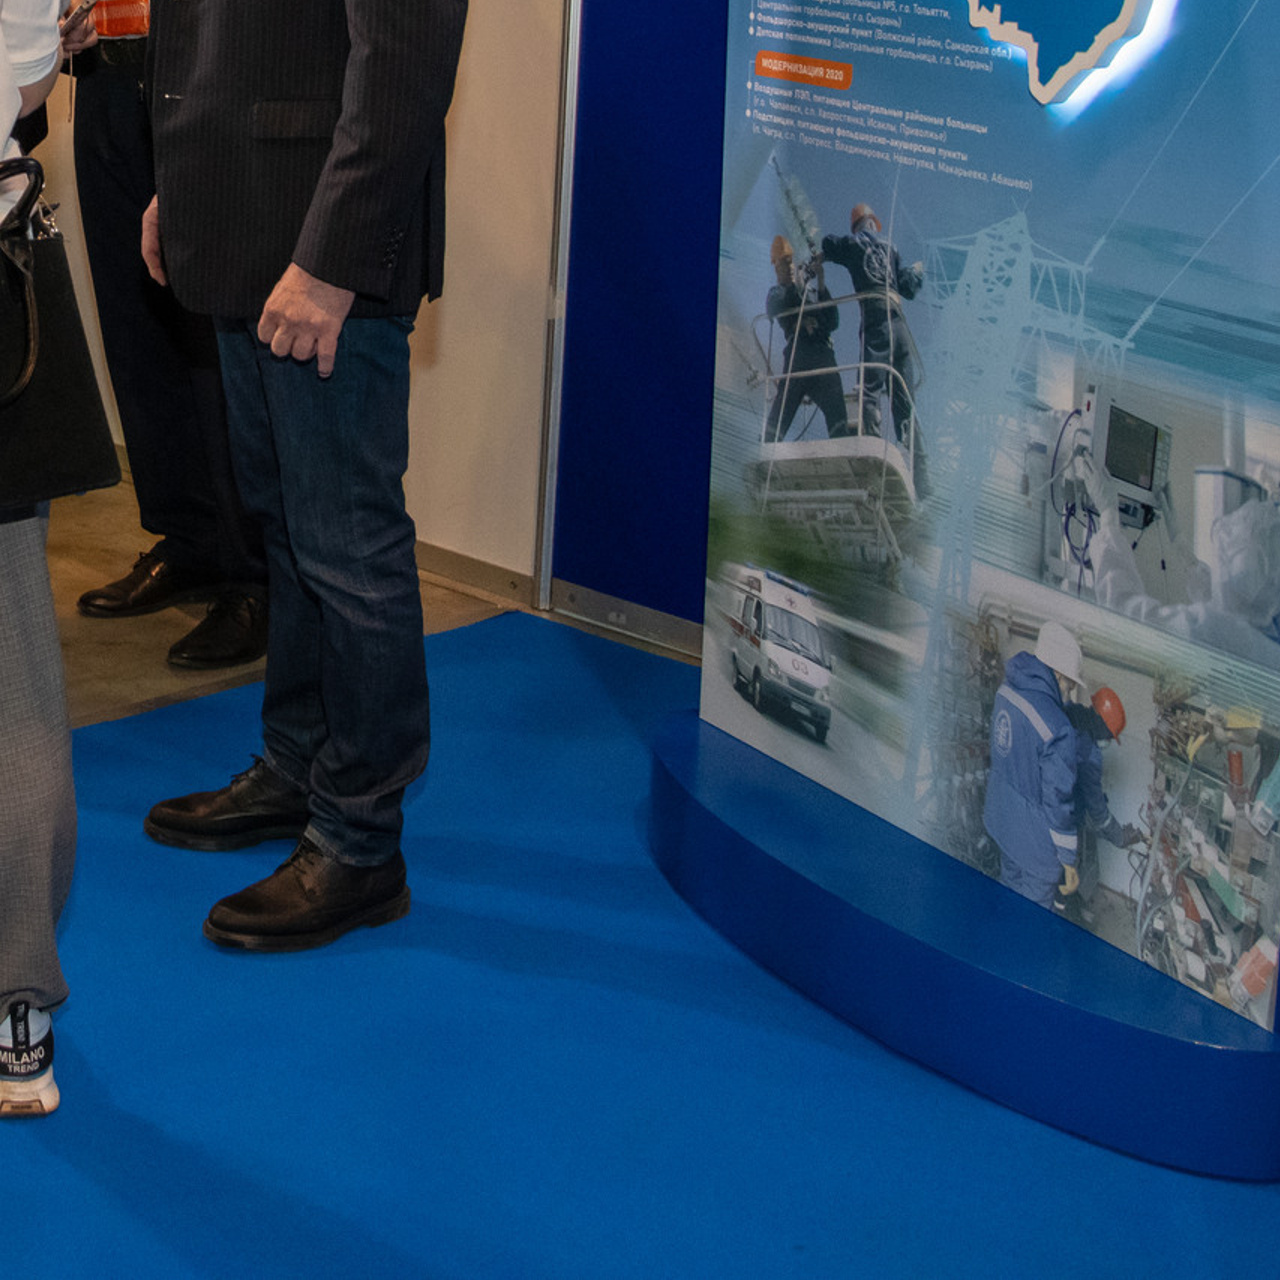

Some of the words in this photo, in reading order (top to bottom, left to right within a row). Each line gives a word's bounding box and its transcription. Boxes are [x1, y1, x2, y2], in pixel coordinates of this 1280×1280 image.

[945, 39, 989, 55] Самарская
[761, 58, 824, 77] МОДЕРНИЗАЦИЯ
[825, 68, 843, 81] 2020
[946, 117, 988, 134] больницы
[7, 1061, 40, 1073] TREND
